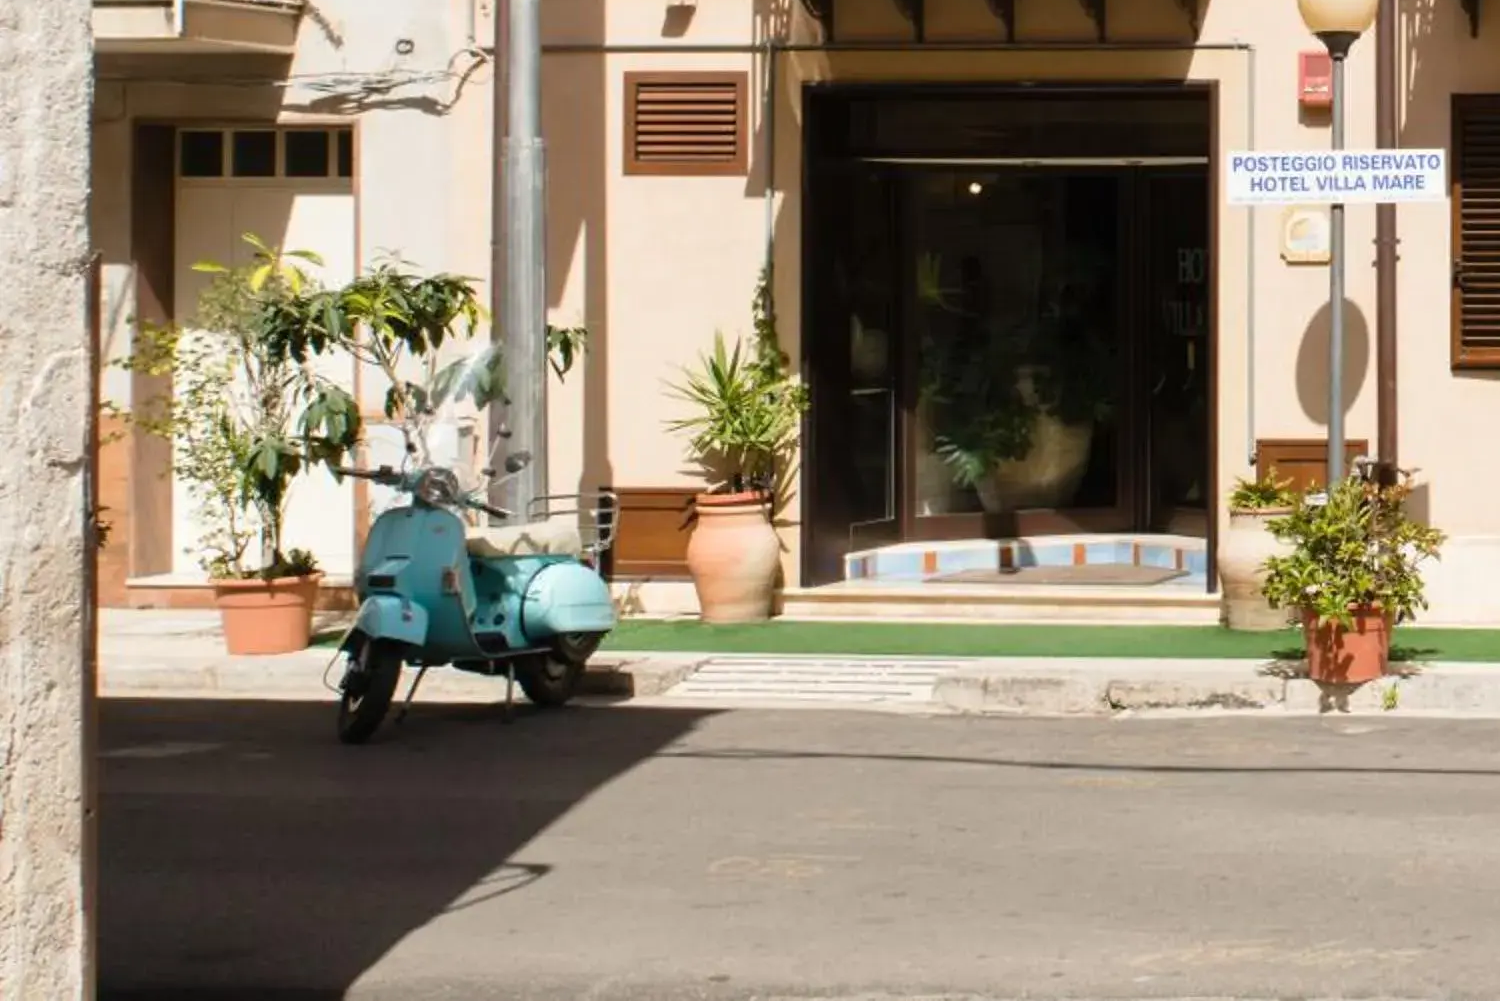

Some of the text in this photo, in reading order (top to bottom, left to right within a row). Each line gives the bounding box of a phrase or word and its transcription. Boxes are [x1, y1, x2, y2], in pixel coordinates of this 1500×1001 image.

[1232, 154, 1441, 172] POSTEGGIO RISERVATO
[1251, 175, 1426, 192] HOTEL VILLA MARE
